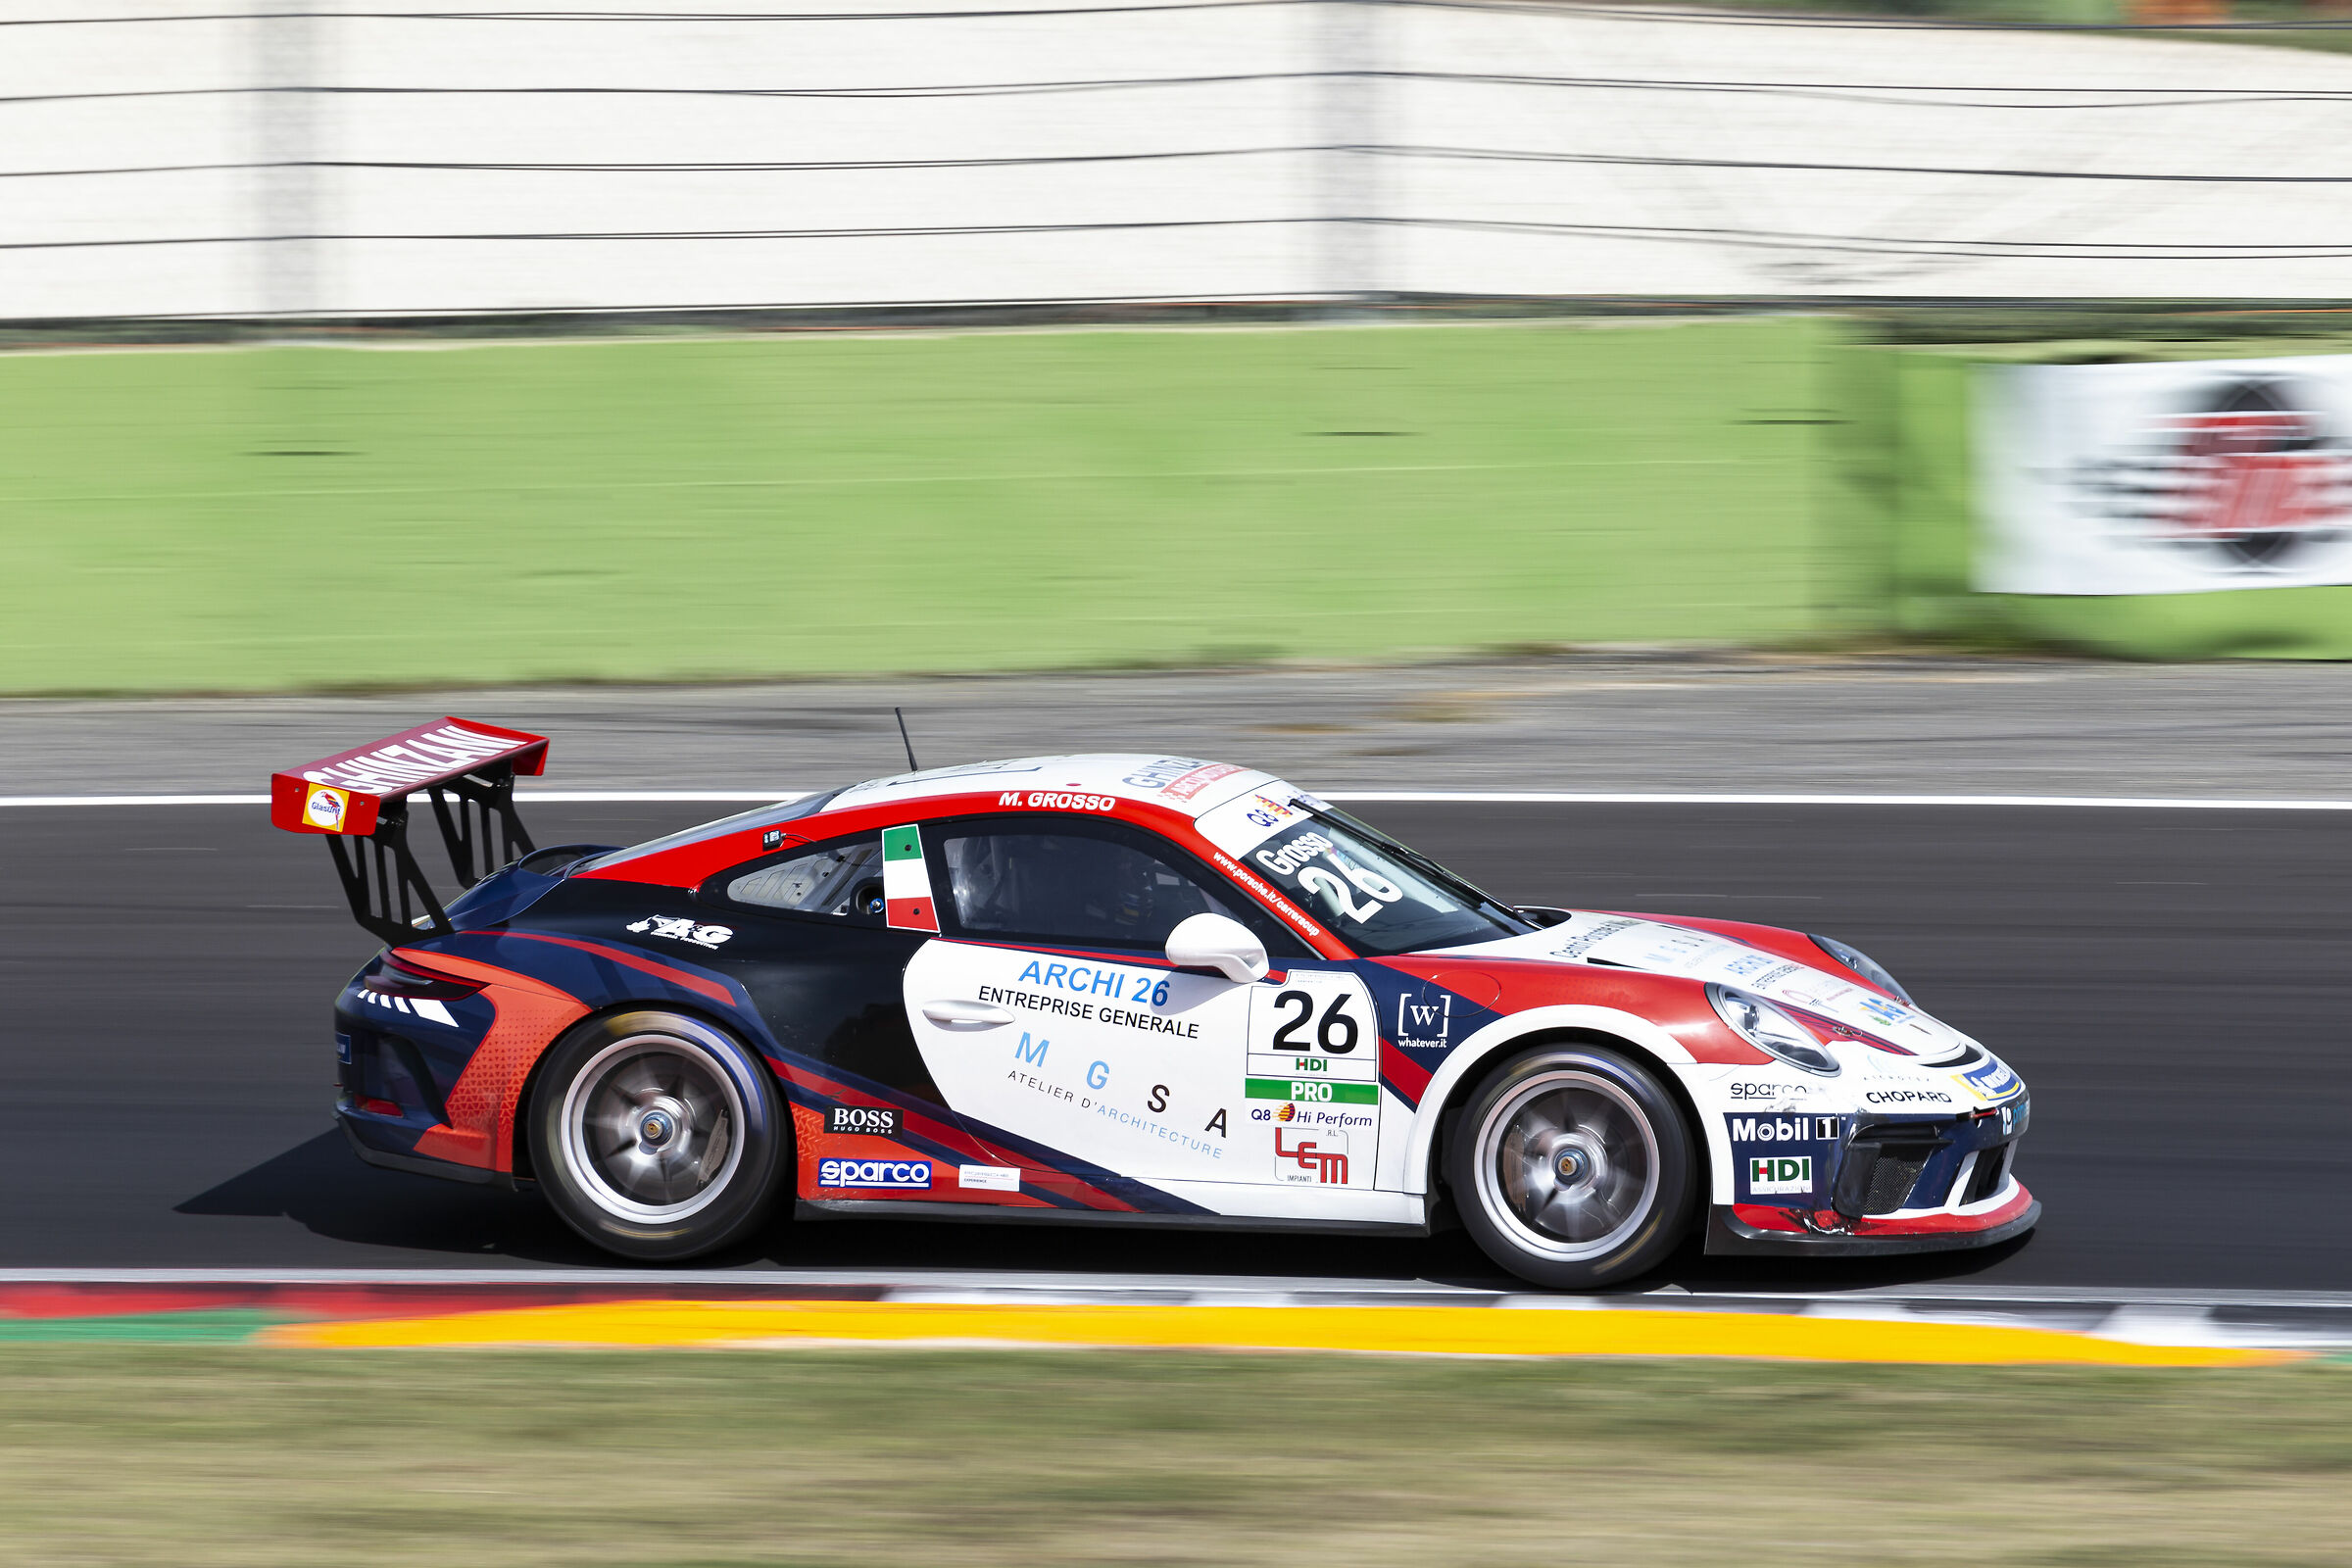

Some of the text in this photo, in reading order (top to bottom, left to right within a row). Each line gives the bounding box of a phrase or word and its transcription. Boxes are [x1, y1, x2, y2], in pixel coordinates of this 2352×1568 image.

[998, 792, 1116, 811] M. GROSSO
[1255, 832, 1334, 875] Grosso
[1213, 852, 1320, 937] www.porsche.it/carreracup
[1298, 853, 1403, 924] 26
[1018, 960, 1171, 1007] ARCHI 26
[978, 986, 1200, 1039] ENTREPRISE GENERALE
[1272, 990, 1358, 1054] 26
[1397, 1037, 1447, 1049] whatever.it
[1295, 1057, 1328, 1072] HDI
[1014, 1031, 1228, 1139] M G S A
[1291, 1082, 1333, 1102] PRO
[1866, 1091, 1952, 1103] CHOPARD
[833, 1107, 894, 1128] BOSS
[1007, 1070, 1224, 1159] ATELIER D'ARCHITECTURE
[1250, 1108, 1373, 1128] Q8 Hi Perform
[1732, 1117, 1809, 1142] Mobil
[820, 1160, 930, 1187] sparco
[1287, 1174, 1312, 1183] IMPIANTI
[1751, 1158, 1810, 1182] HDI
